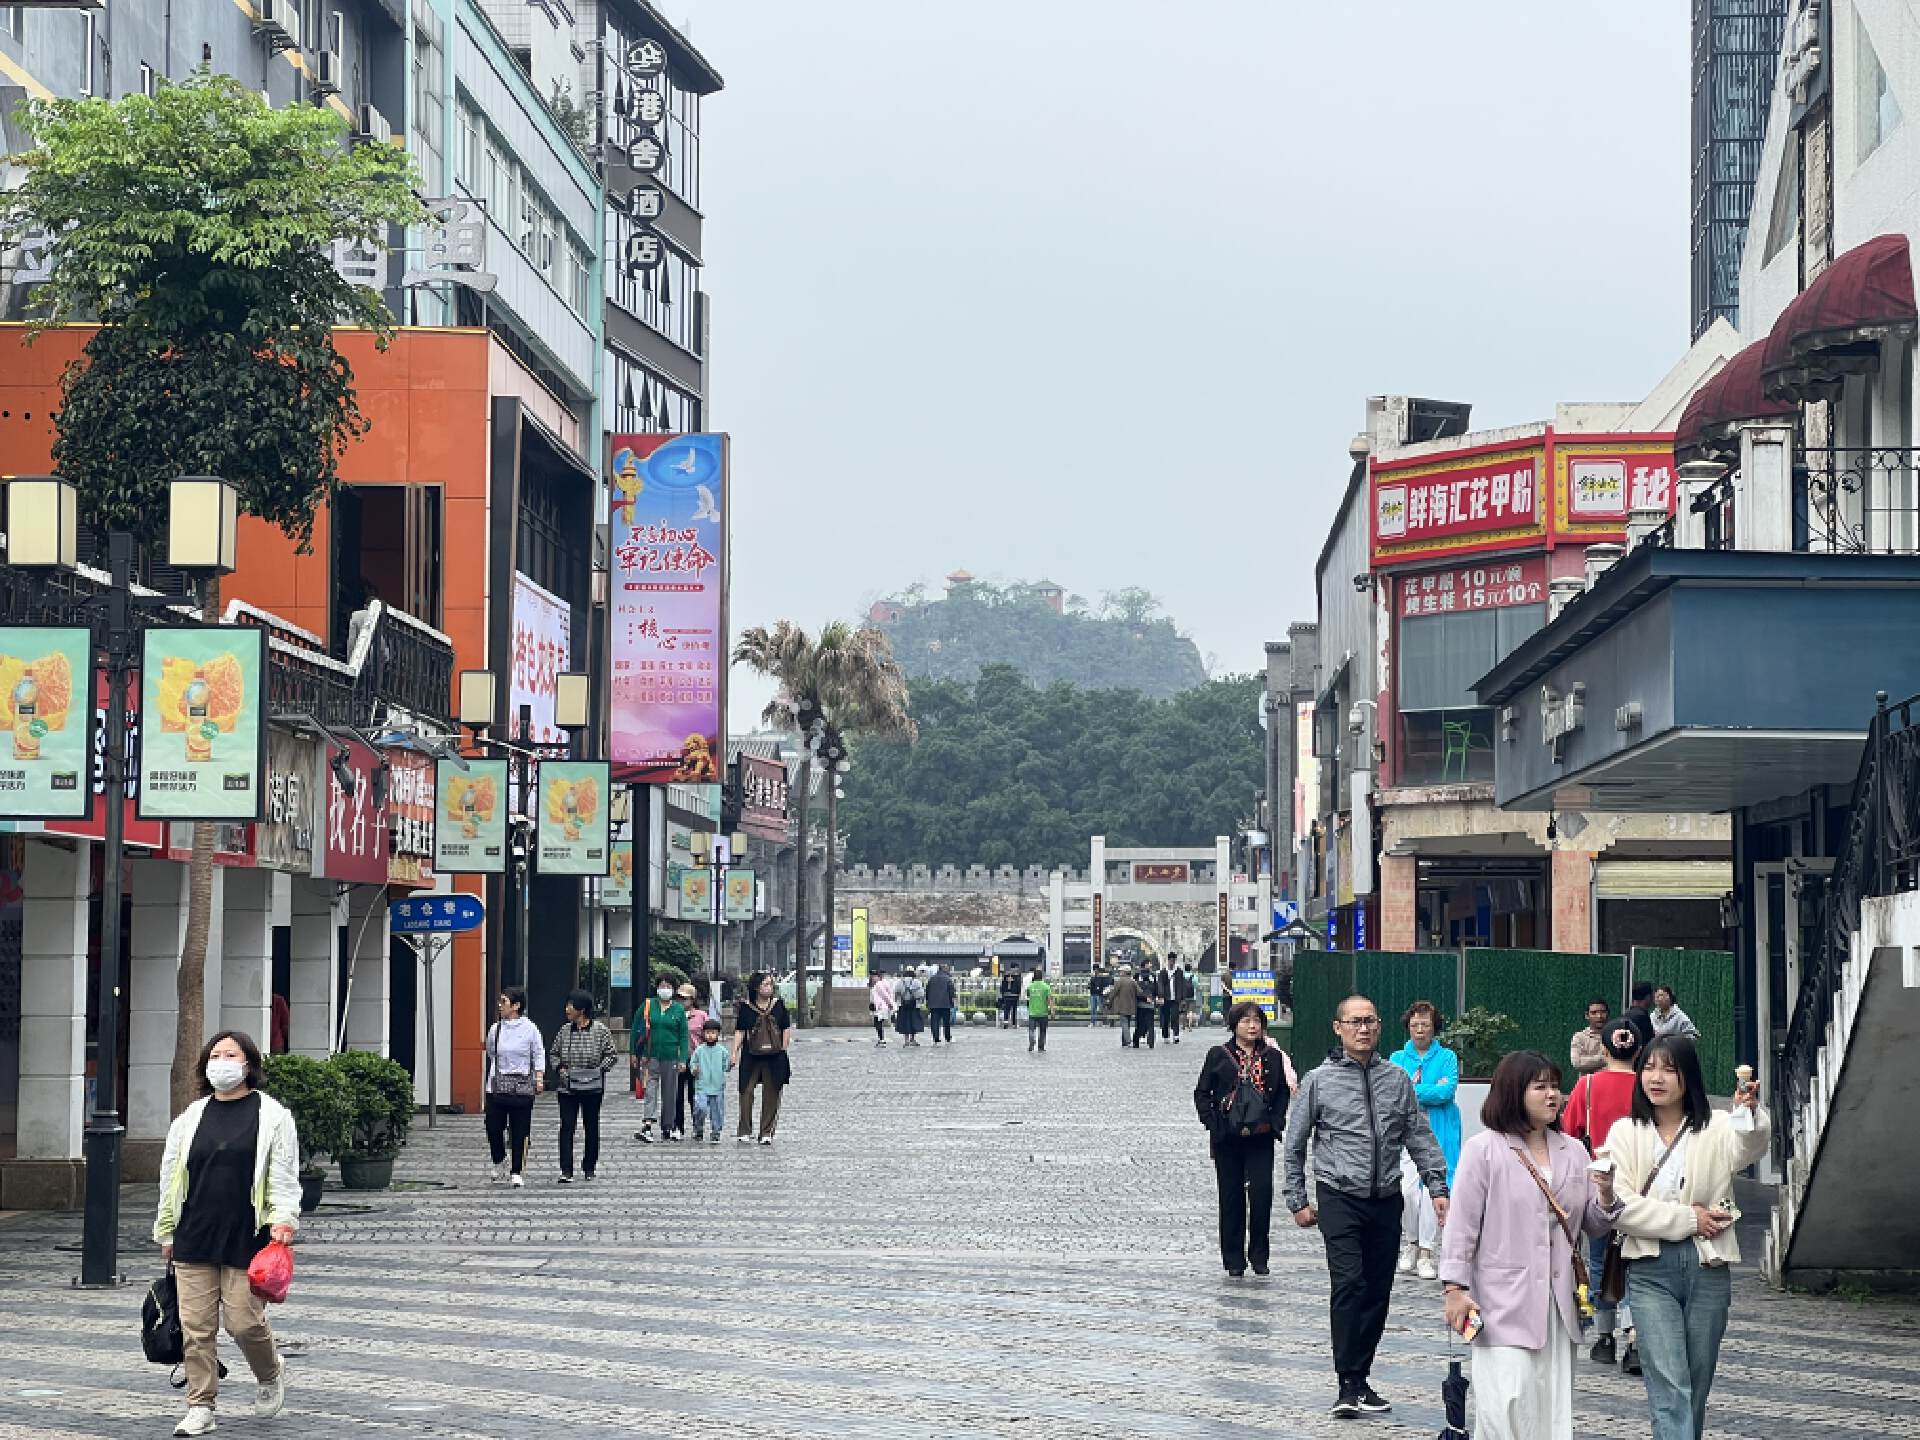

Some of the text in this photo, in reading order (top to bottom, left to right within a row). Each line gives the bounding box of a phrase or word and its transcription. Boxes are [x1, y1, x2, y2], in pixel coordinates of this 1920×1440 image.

[1409, 468, 1533, 529] 鲜海汇花甲粉
[631, 519, 699, 544] 不忘初心
[614, 540, 718, 580] 牢记使命
